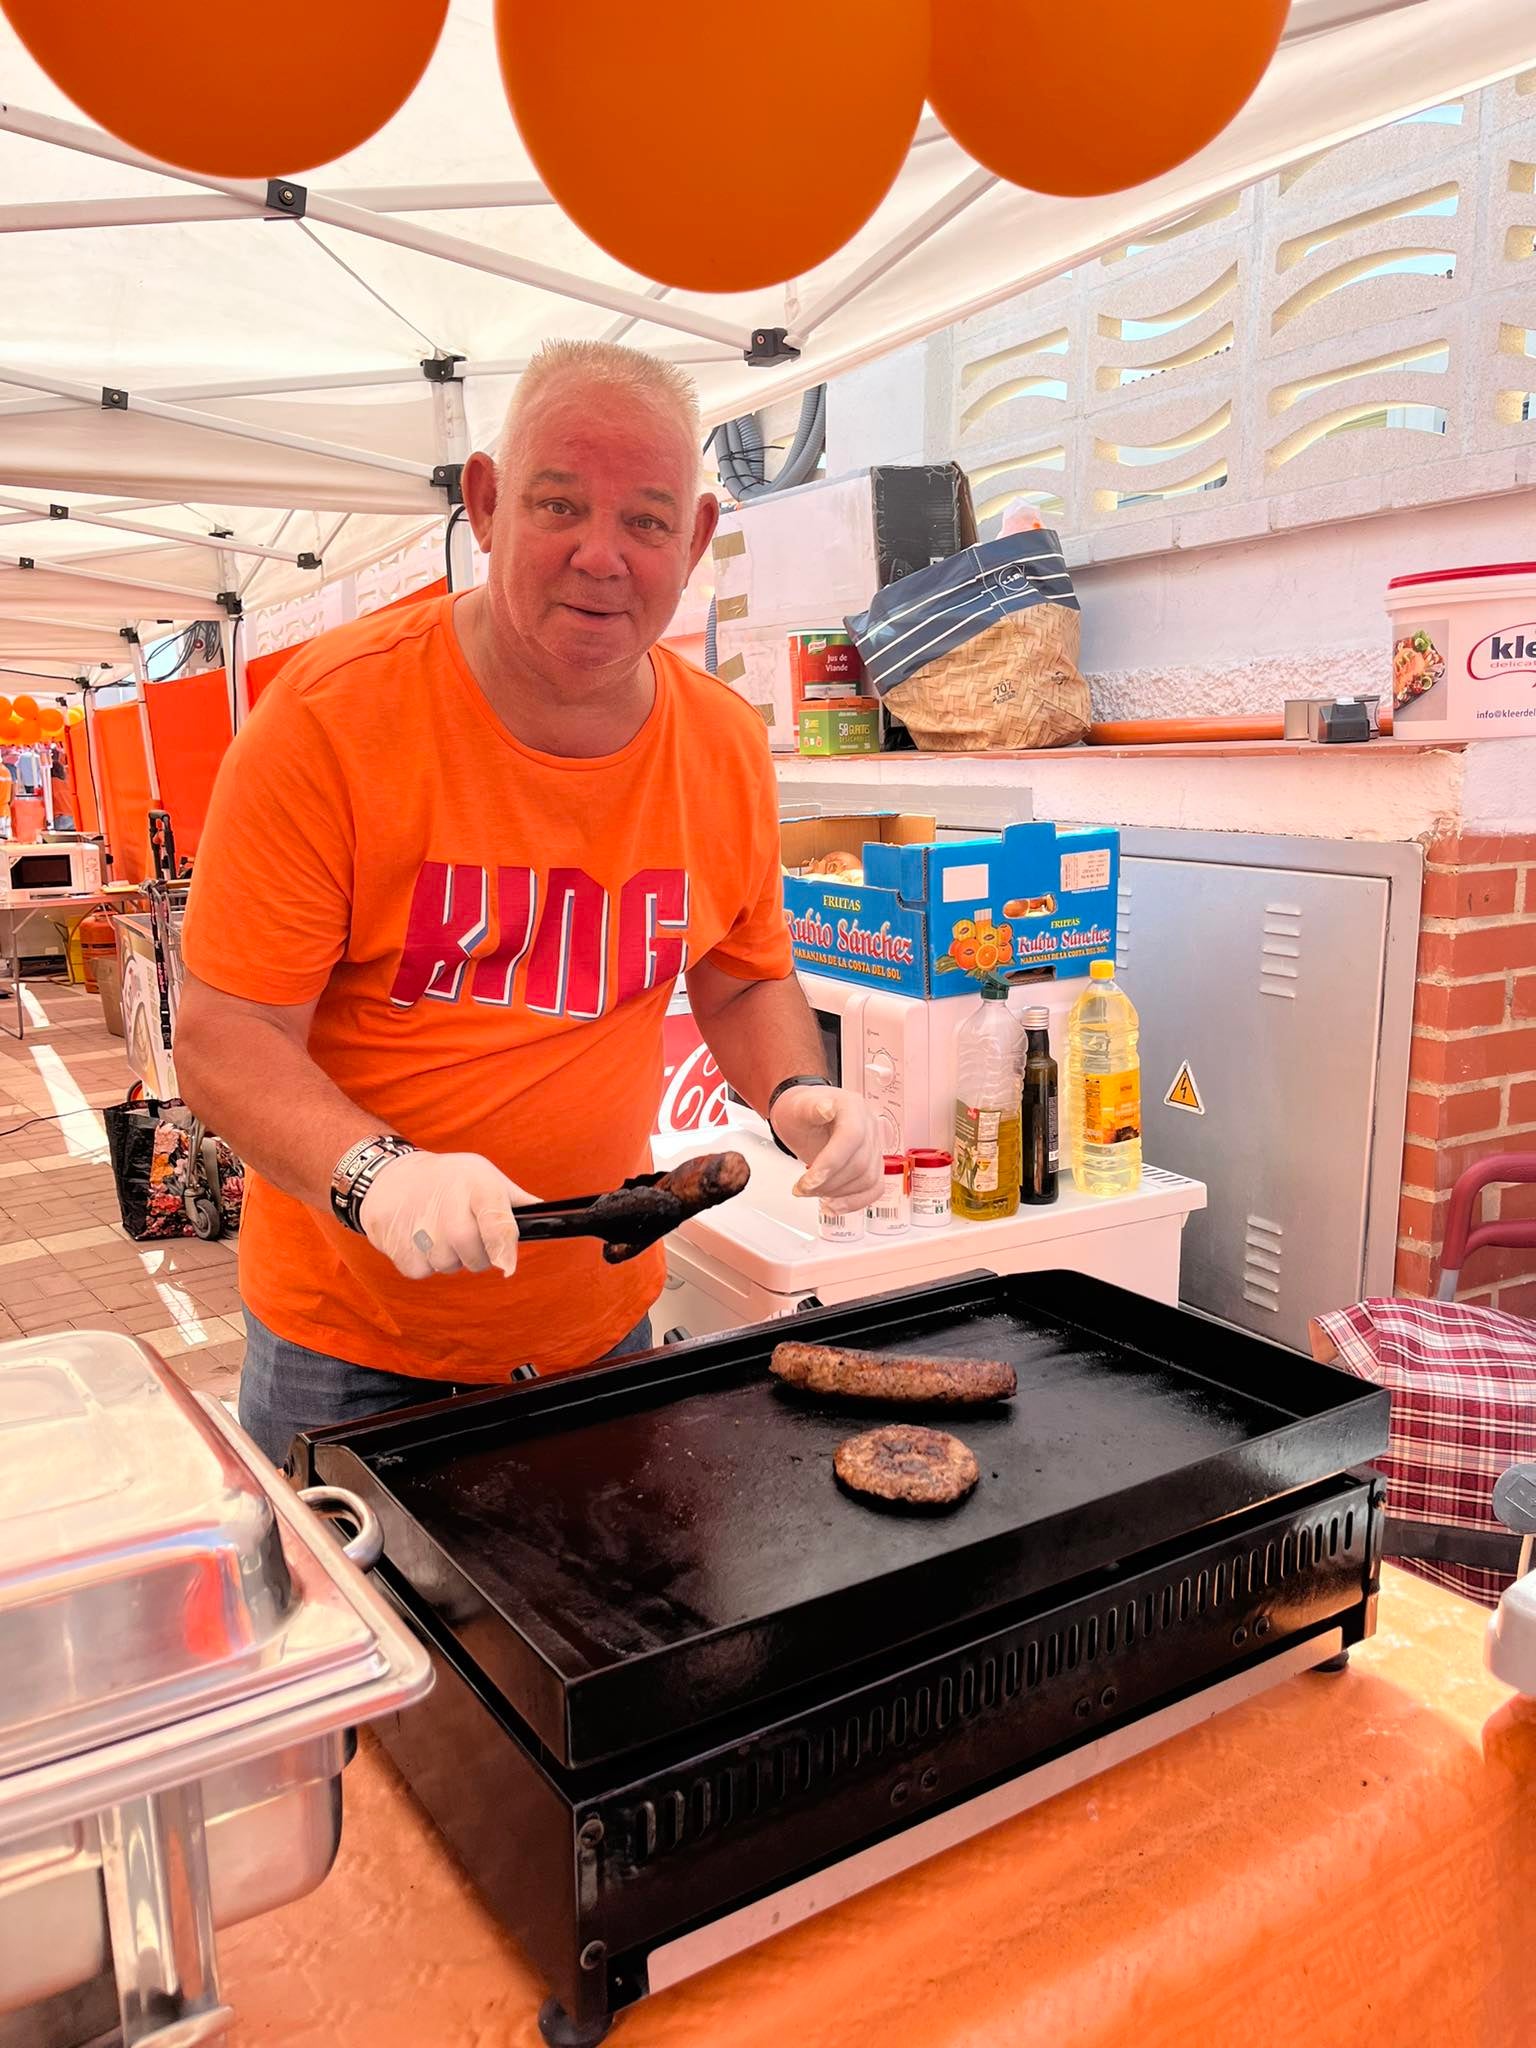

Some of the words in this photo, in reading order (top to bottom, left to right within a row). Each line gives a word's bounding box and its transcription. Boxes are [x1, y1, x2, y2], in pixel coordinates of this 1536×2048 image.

[827, 654, 838, 664] Jus
[839, 653, 848, 662] de
[825, 663, 849, 672] Viande
[823, 895, 861, 911] FRUTAS
[1050, 918, 1080, 929] FRUTAS
[837, 918, 914, 965] Sánchez
[1016, 931, 1058, 956] Rubio
[1061, 924, 1112, 949] Sánchez
[794, 948, 828, 963] NARANJAS
[828, 955, 838, 965] DE
[838, 958, 848, 968] LA
[849, 959, 871, 973] COSTA
[872, 964, 887, 976] DEL
[886, 967, 902, 980] SOL
